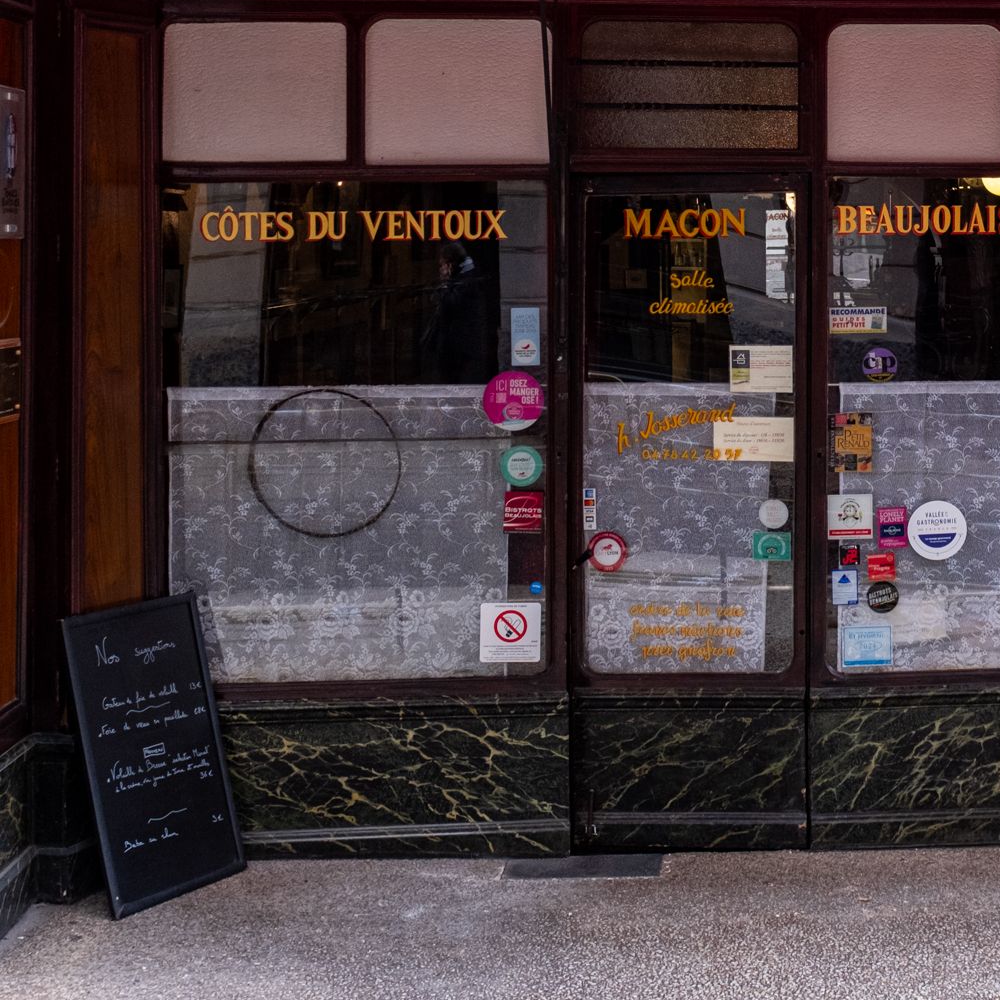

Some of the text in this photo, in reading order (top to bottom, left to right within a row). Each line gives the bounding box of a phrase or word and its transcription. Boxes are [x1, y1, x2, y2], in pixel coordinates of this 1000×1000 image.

[200, 206, 509, 242] CÔTES DU VENTOUX
[623, 208, 747, 240] MACON
[670, 269, 715, 289] Salle
[648, 297, 735, 315] climatisée
[509, 379, 528, 387] OSEZ
[509, 388, 540, 396] MANGER
[916, 519, 957, 527] GASTRONOMIE
[95, 636, 120, 667] Nos
